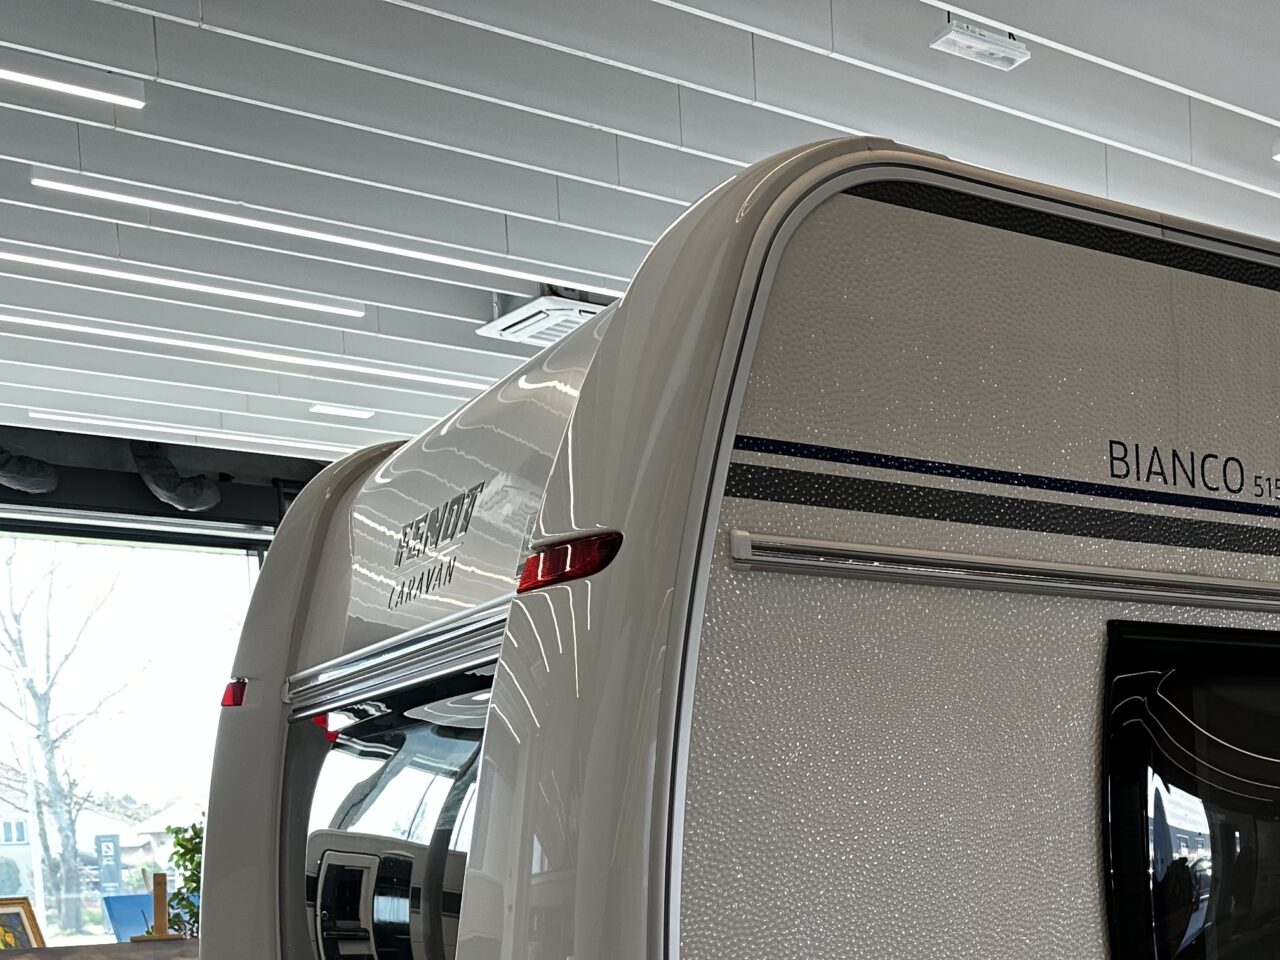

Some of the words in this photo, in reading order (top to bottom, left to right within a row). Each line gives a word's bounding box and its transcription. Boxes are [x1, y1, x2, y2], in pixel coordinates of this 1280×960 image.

[1108, 438, 1245, 494] BIANCO
[393, 480, 485, 568] FENDT
[388, 556, 457, 611] CARAVAN
